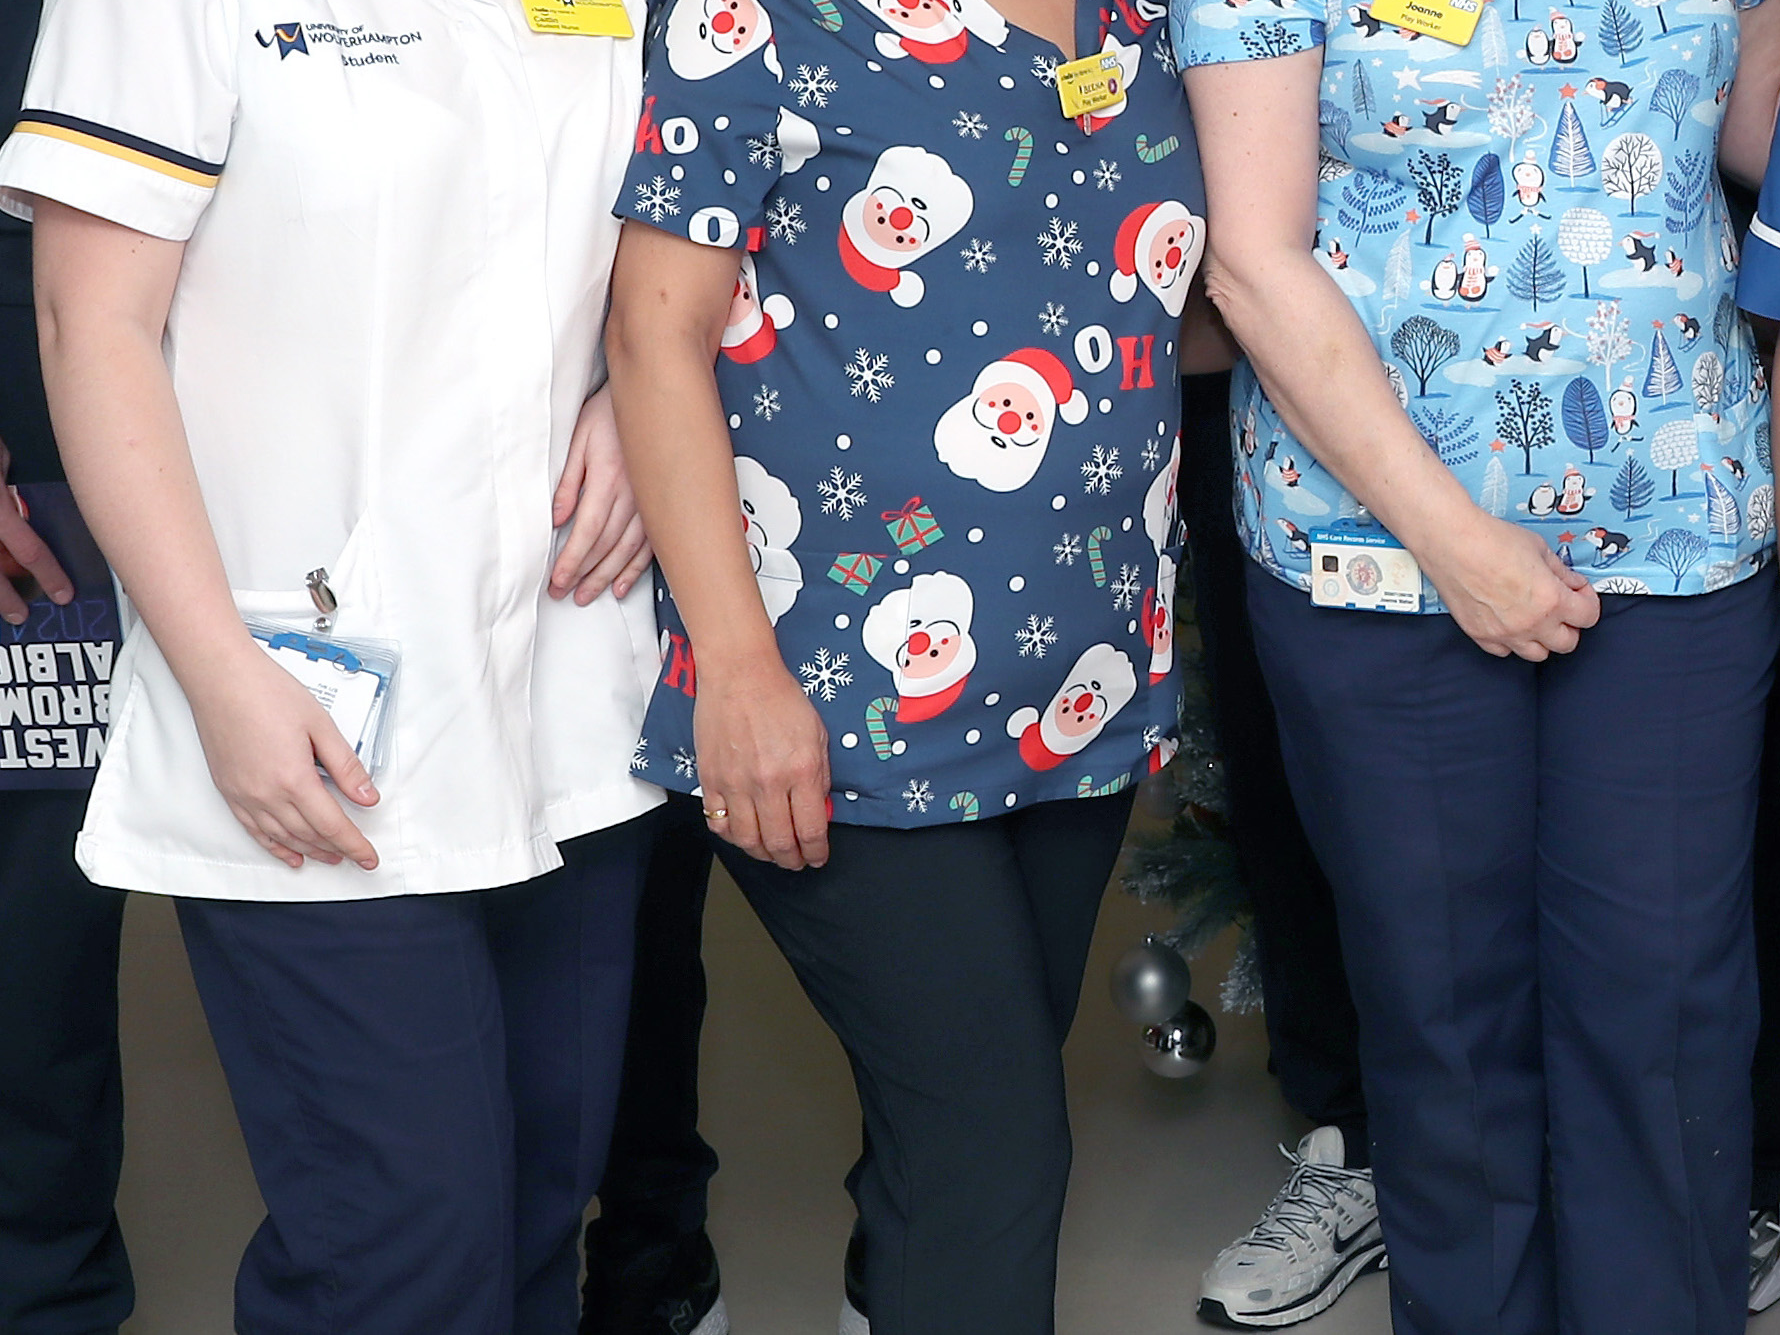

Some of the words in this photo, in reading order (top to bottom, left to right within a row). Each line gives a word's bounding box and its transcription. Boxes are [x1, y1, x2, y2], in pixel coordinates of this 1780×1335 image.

[1405, 1, 1443, 19] Joanne
[351, 24, 365, 34] OF
[308, 31, 423, 48] WOLVERHAMPTON
[341, 52, 400, 67] Student
